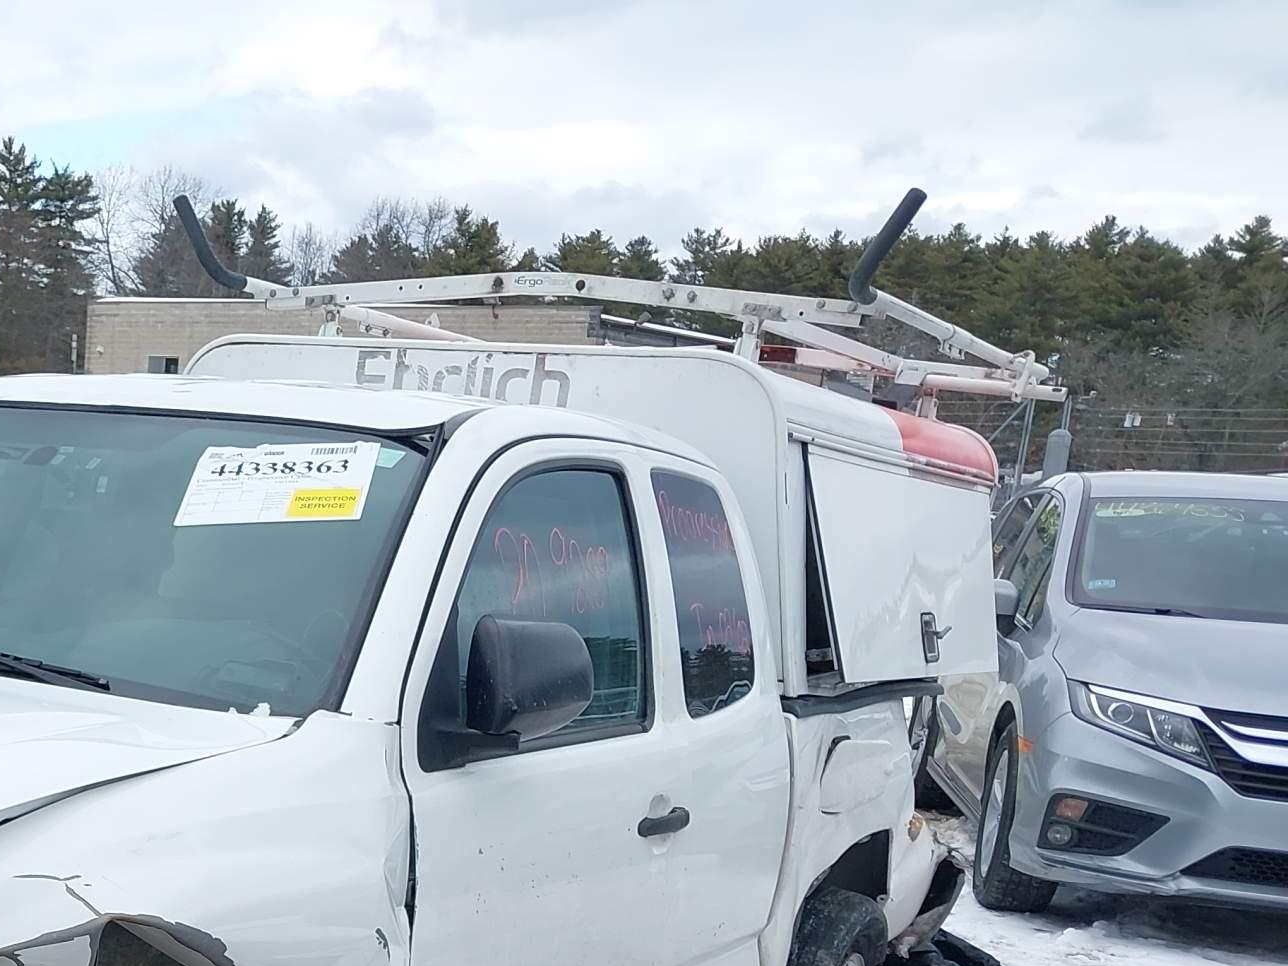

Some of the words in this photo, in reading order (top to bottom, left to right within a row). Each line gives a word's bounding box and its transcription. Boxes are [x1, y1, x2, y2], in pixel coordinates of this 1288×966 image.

[355, 348, 571, 408] Ehrlich
[210, 458, 349, 477] 44338363
[294, 495, 357, 503] INSPECTION
